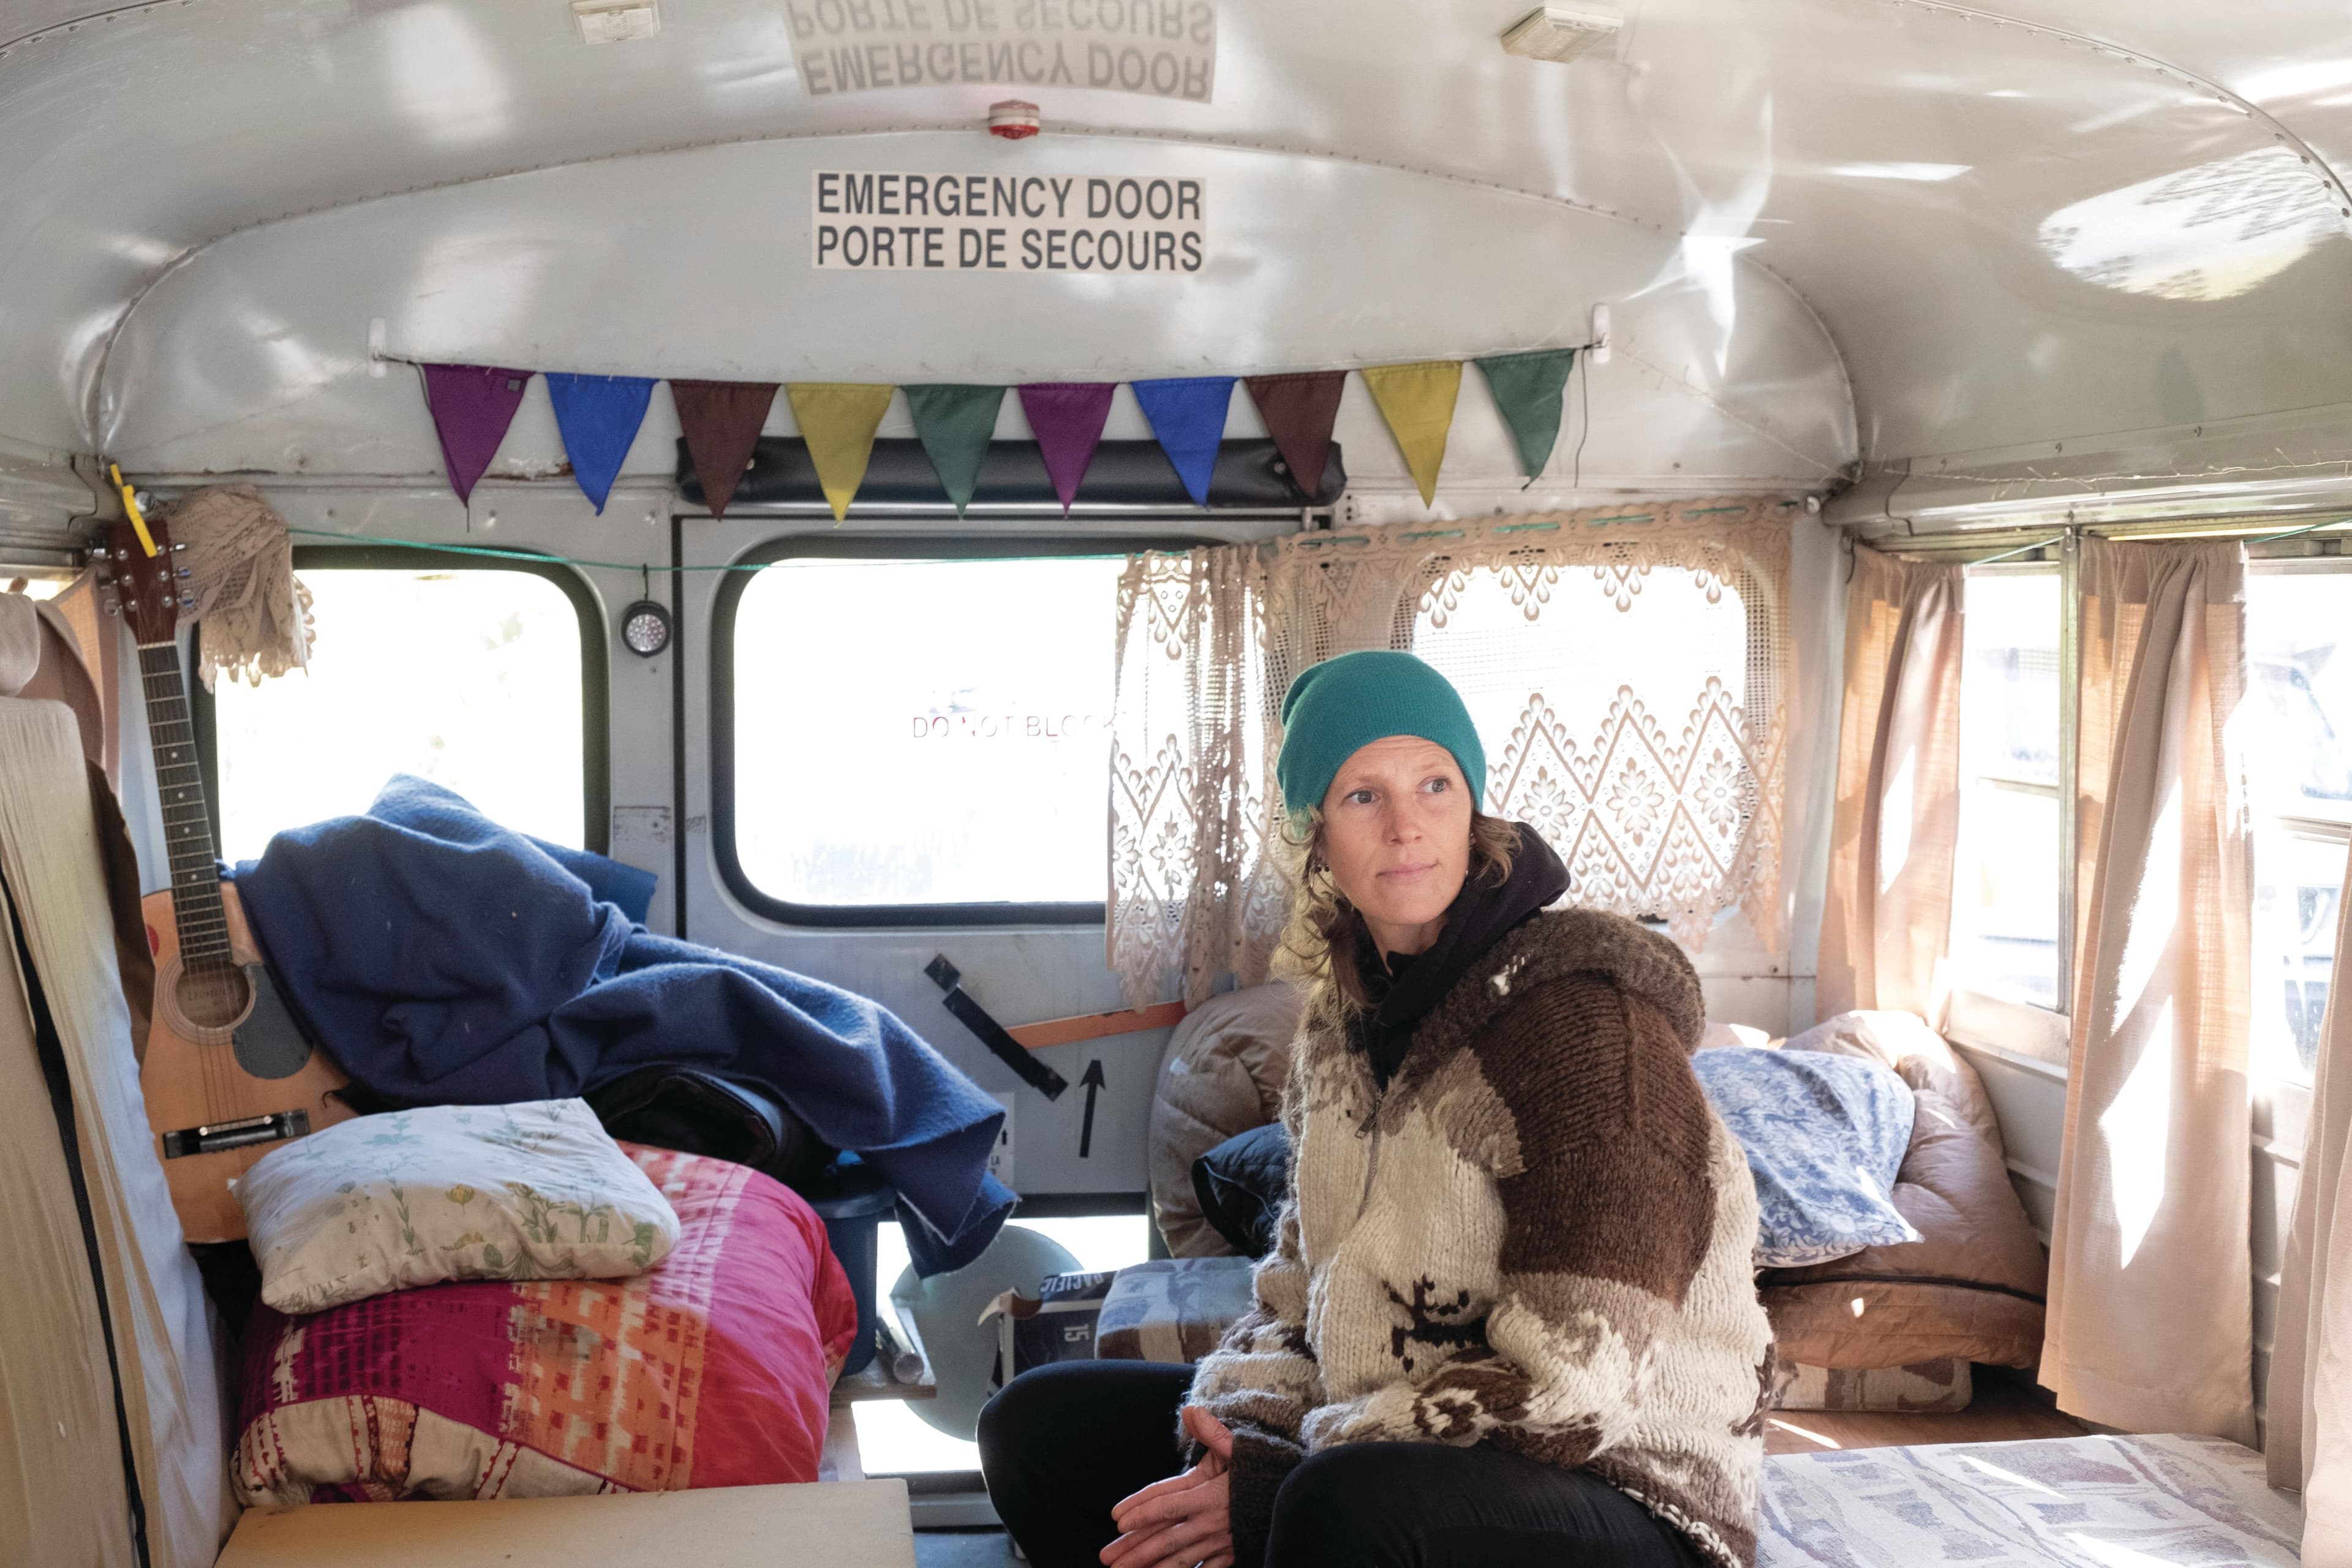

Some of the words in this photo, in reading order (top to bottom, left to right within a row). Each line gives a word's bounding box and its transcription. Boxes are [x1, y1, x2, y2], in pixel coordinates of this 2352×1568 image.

[818, 173, 1073, 217] EMERGENCY
[1087, 179, 1200, 220] DOOR
[818, 225, 944, 267] PORTE
[959, 228, 1007, 268] DE
[1021, 229, 1202, 271] SECOURS
[913, 716, 949, 737] DO
[962, 716, 1015, 737] NOT
[1064, 1324, 1089, 1342] 15
